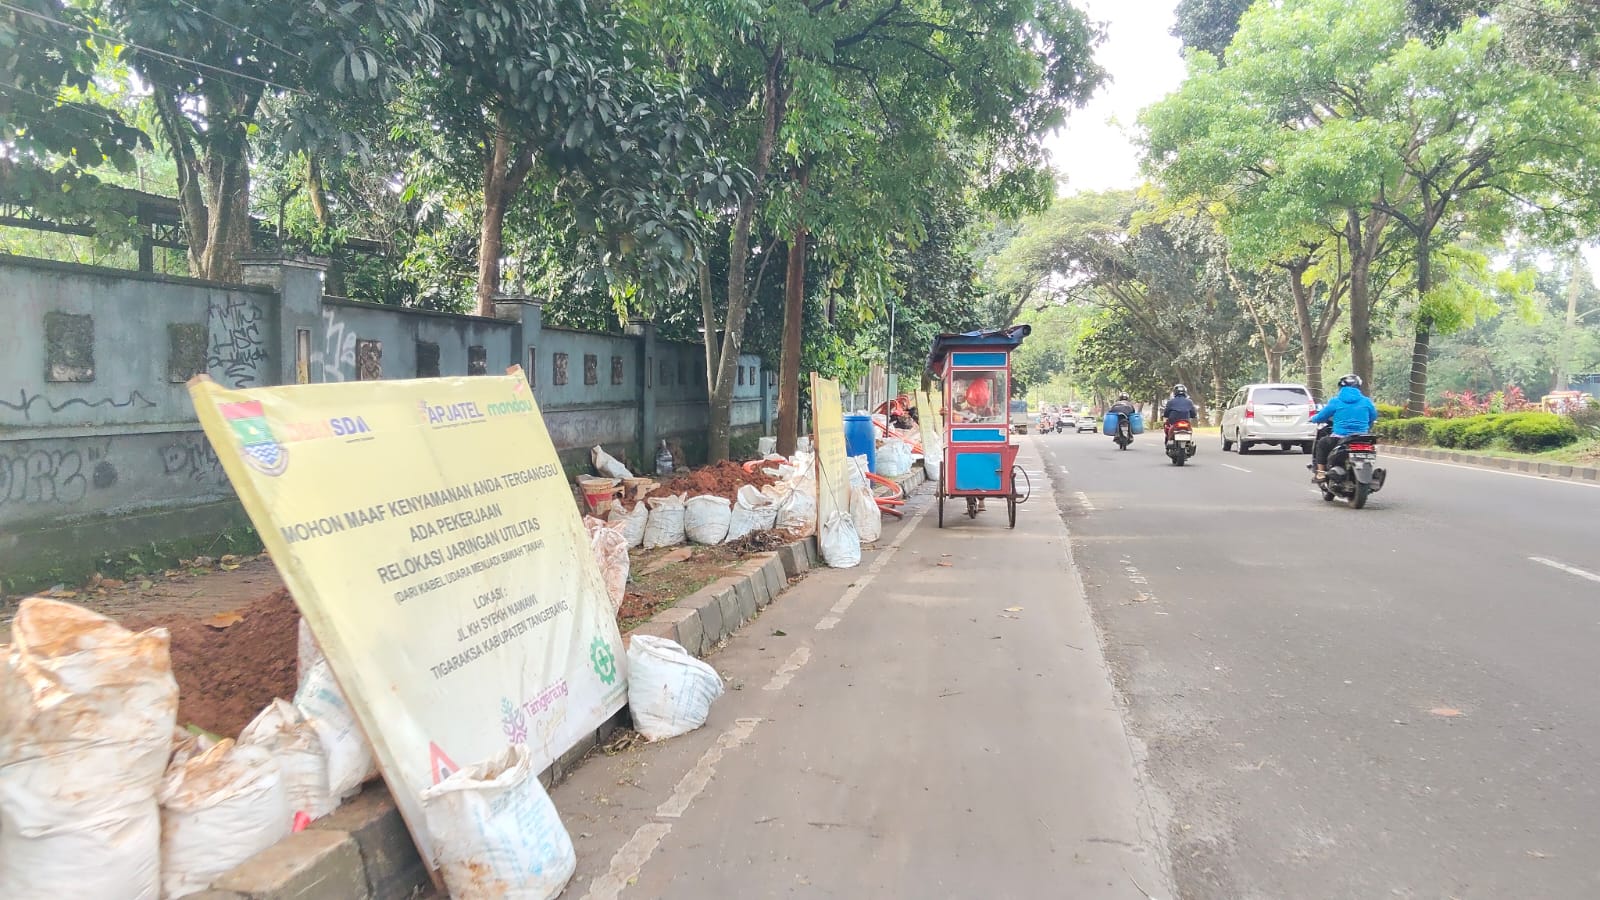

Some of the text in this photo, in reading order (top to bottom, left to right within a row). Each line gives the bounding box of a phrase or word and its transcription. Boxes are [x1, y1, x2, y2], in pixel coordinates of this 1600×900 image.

[427, 401, 484, 424] APJATEL
[280, 463, 559, 544] MOHON MAAF KENYAMANAN ANDA TERGANGGU
[409, 503, 503, 542] ADA PEKERJAAN
[377, 517, 541, 584] RELOKASI JARINGAN UTILITAS
[394, 539, 545, 605] (DARI KABEL UDARA MENJADI BAWAH TANAH)
[481, 610, 508, 630] SYEKH
[508, 593, 538, 618] NAWAWI
[430, 599, 569, 680] TIGARAKSA KABUPATEN TANGERANG
[523, 680, 569, 717] Tangerang
